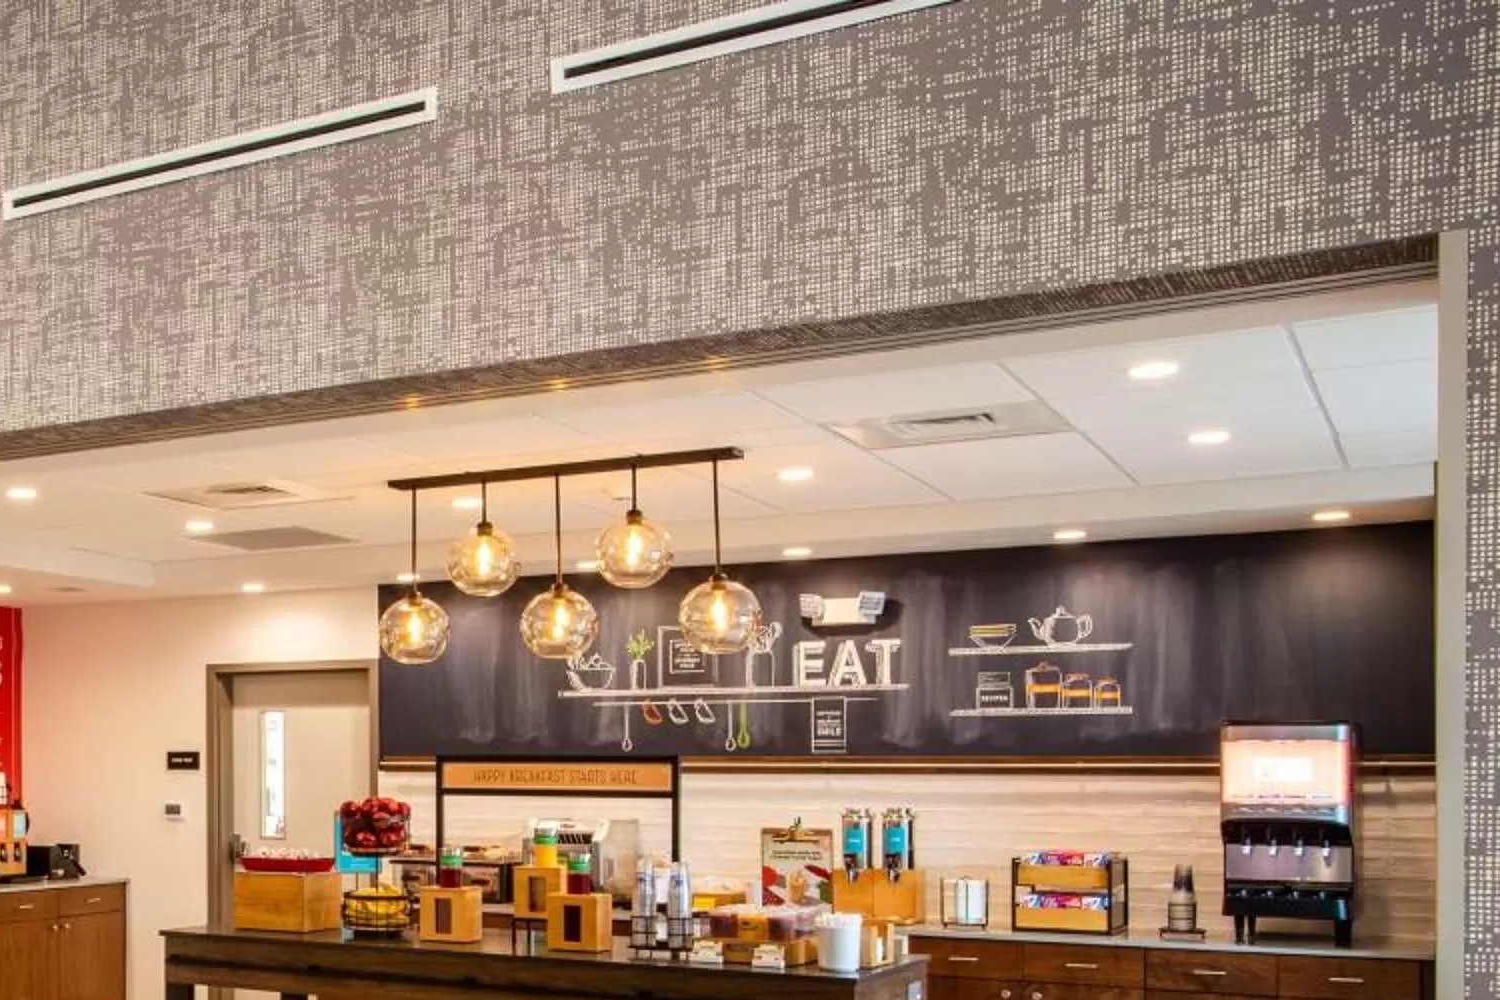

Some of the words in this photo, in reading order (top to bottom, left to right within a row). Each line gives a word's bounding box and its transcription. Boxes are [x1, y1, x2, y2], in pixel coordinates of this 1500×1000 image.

[793, 638, 902, 687] EAT
[473, 769, 505, 783] HAPPY
[509, 769, 565, 784] BREAKFAST
